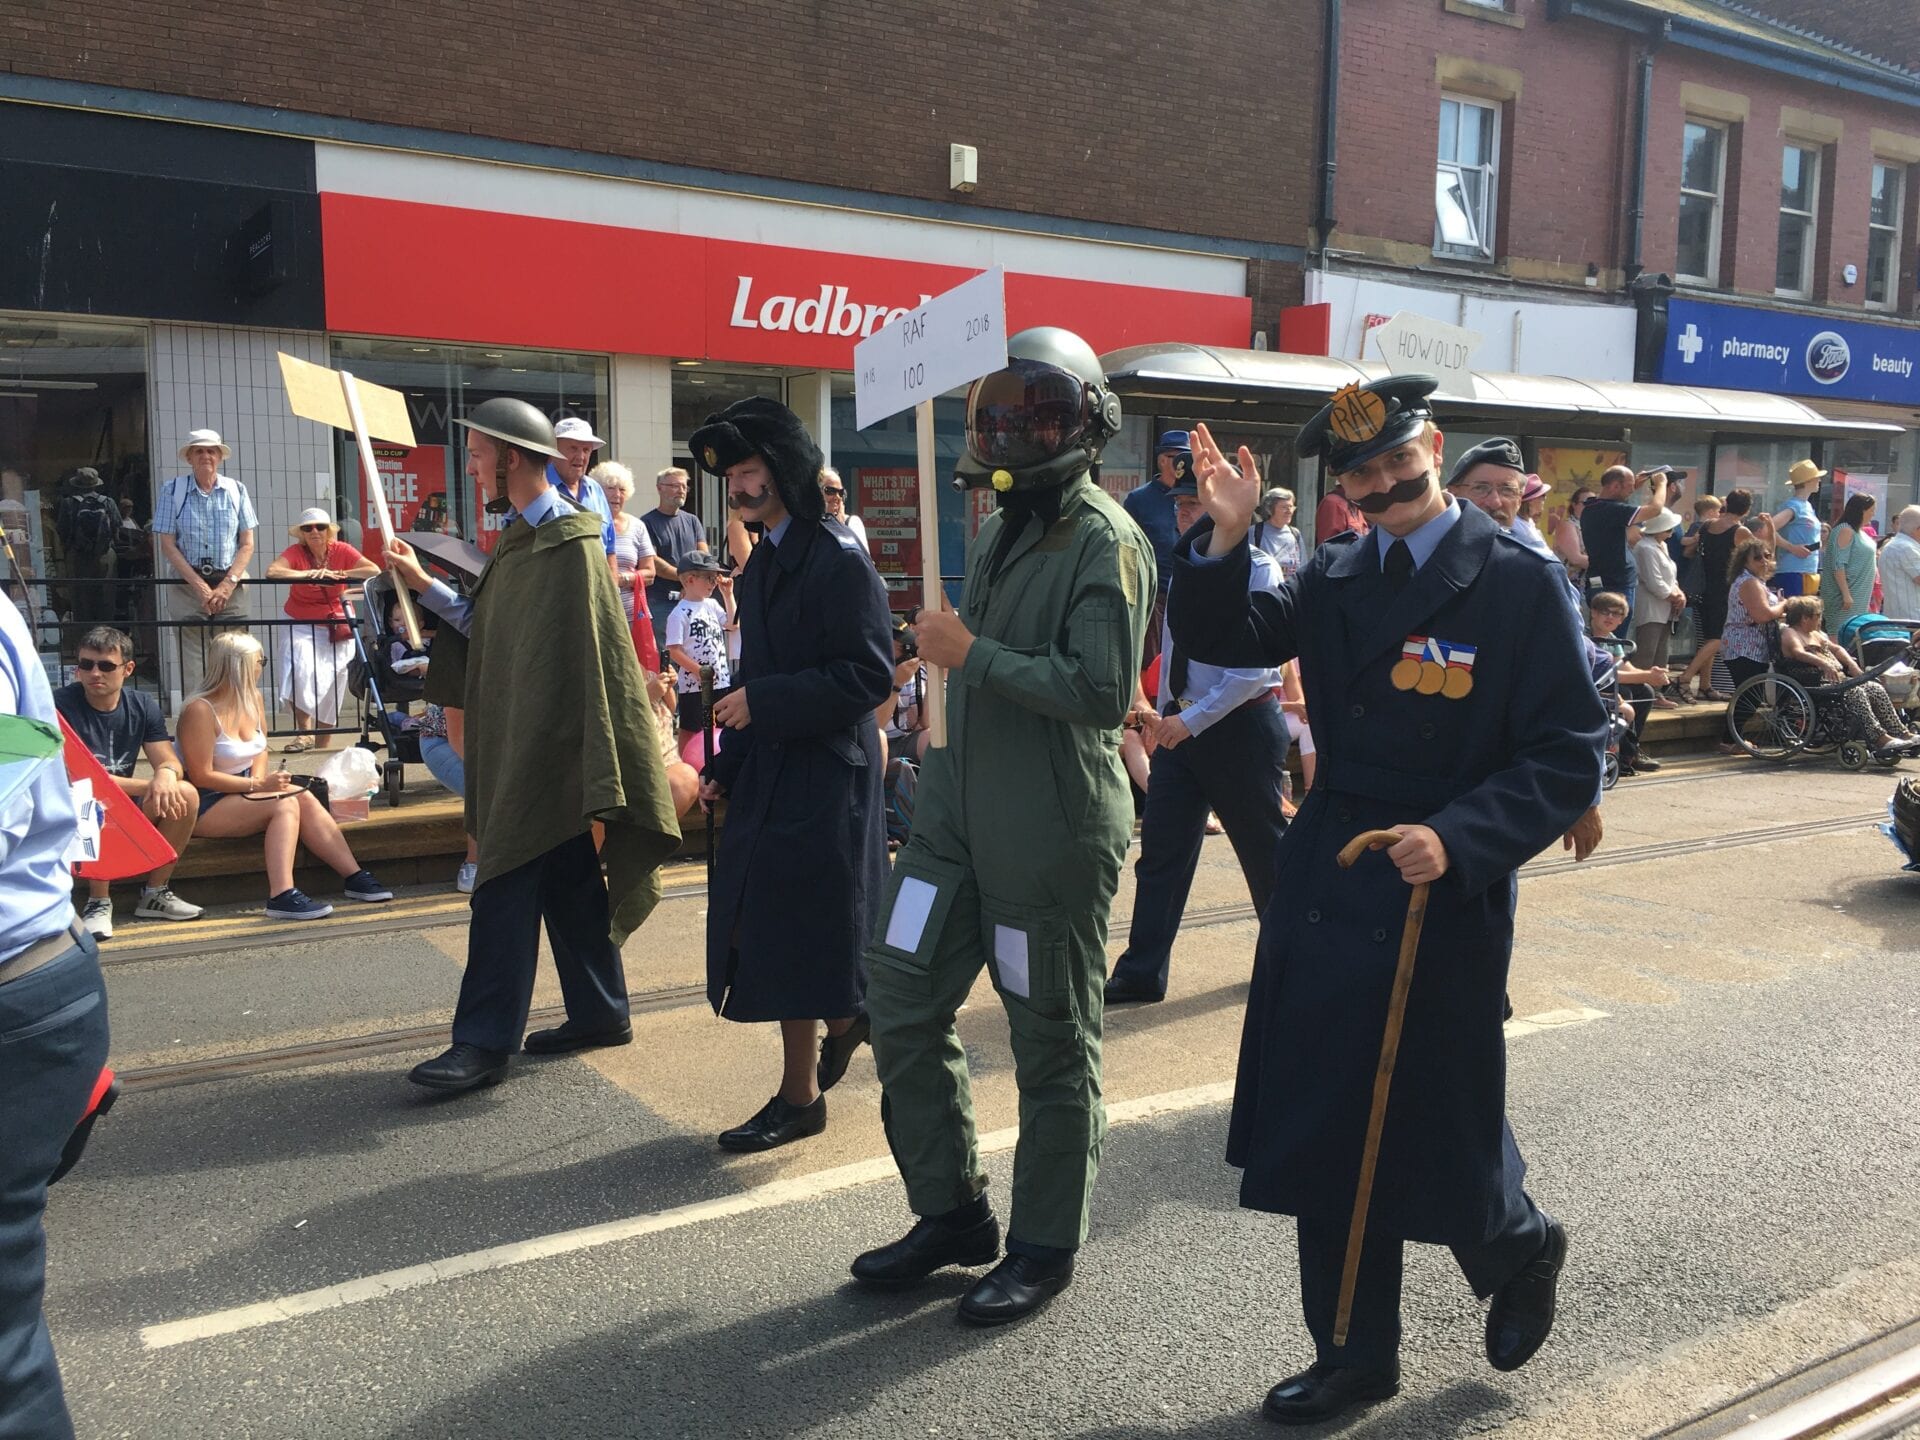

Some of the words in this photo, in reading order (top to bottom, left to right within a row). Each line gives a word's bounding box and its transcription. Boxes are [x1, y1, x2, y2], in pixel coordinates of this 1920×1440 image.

[730, 275, 934, 338] Ladbro
[903, 311, 927, 348] RAF
[965, 313, 990, 342] 2018
[1398, 330, 1434, 361] HOW
[1435, 340, 1469, 370] OLD?
[1722, 336, 1790, 365] pharmacy
[1872, 353, 1913, 378] beauty
[903, 362, 924, 391] 100
[1333, 390, 1379, 441] RAF
[863, 475, 898, 488] WHAT'S
[899, 475, 916, 488] THE
[871, 488, 907, 502] SCORE?
